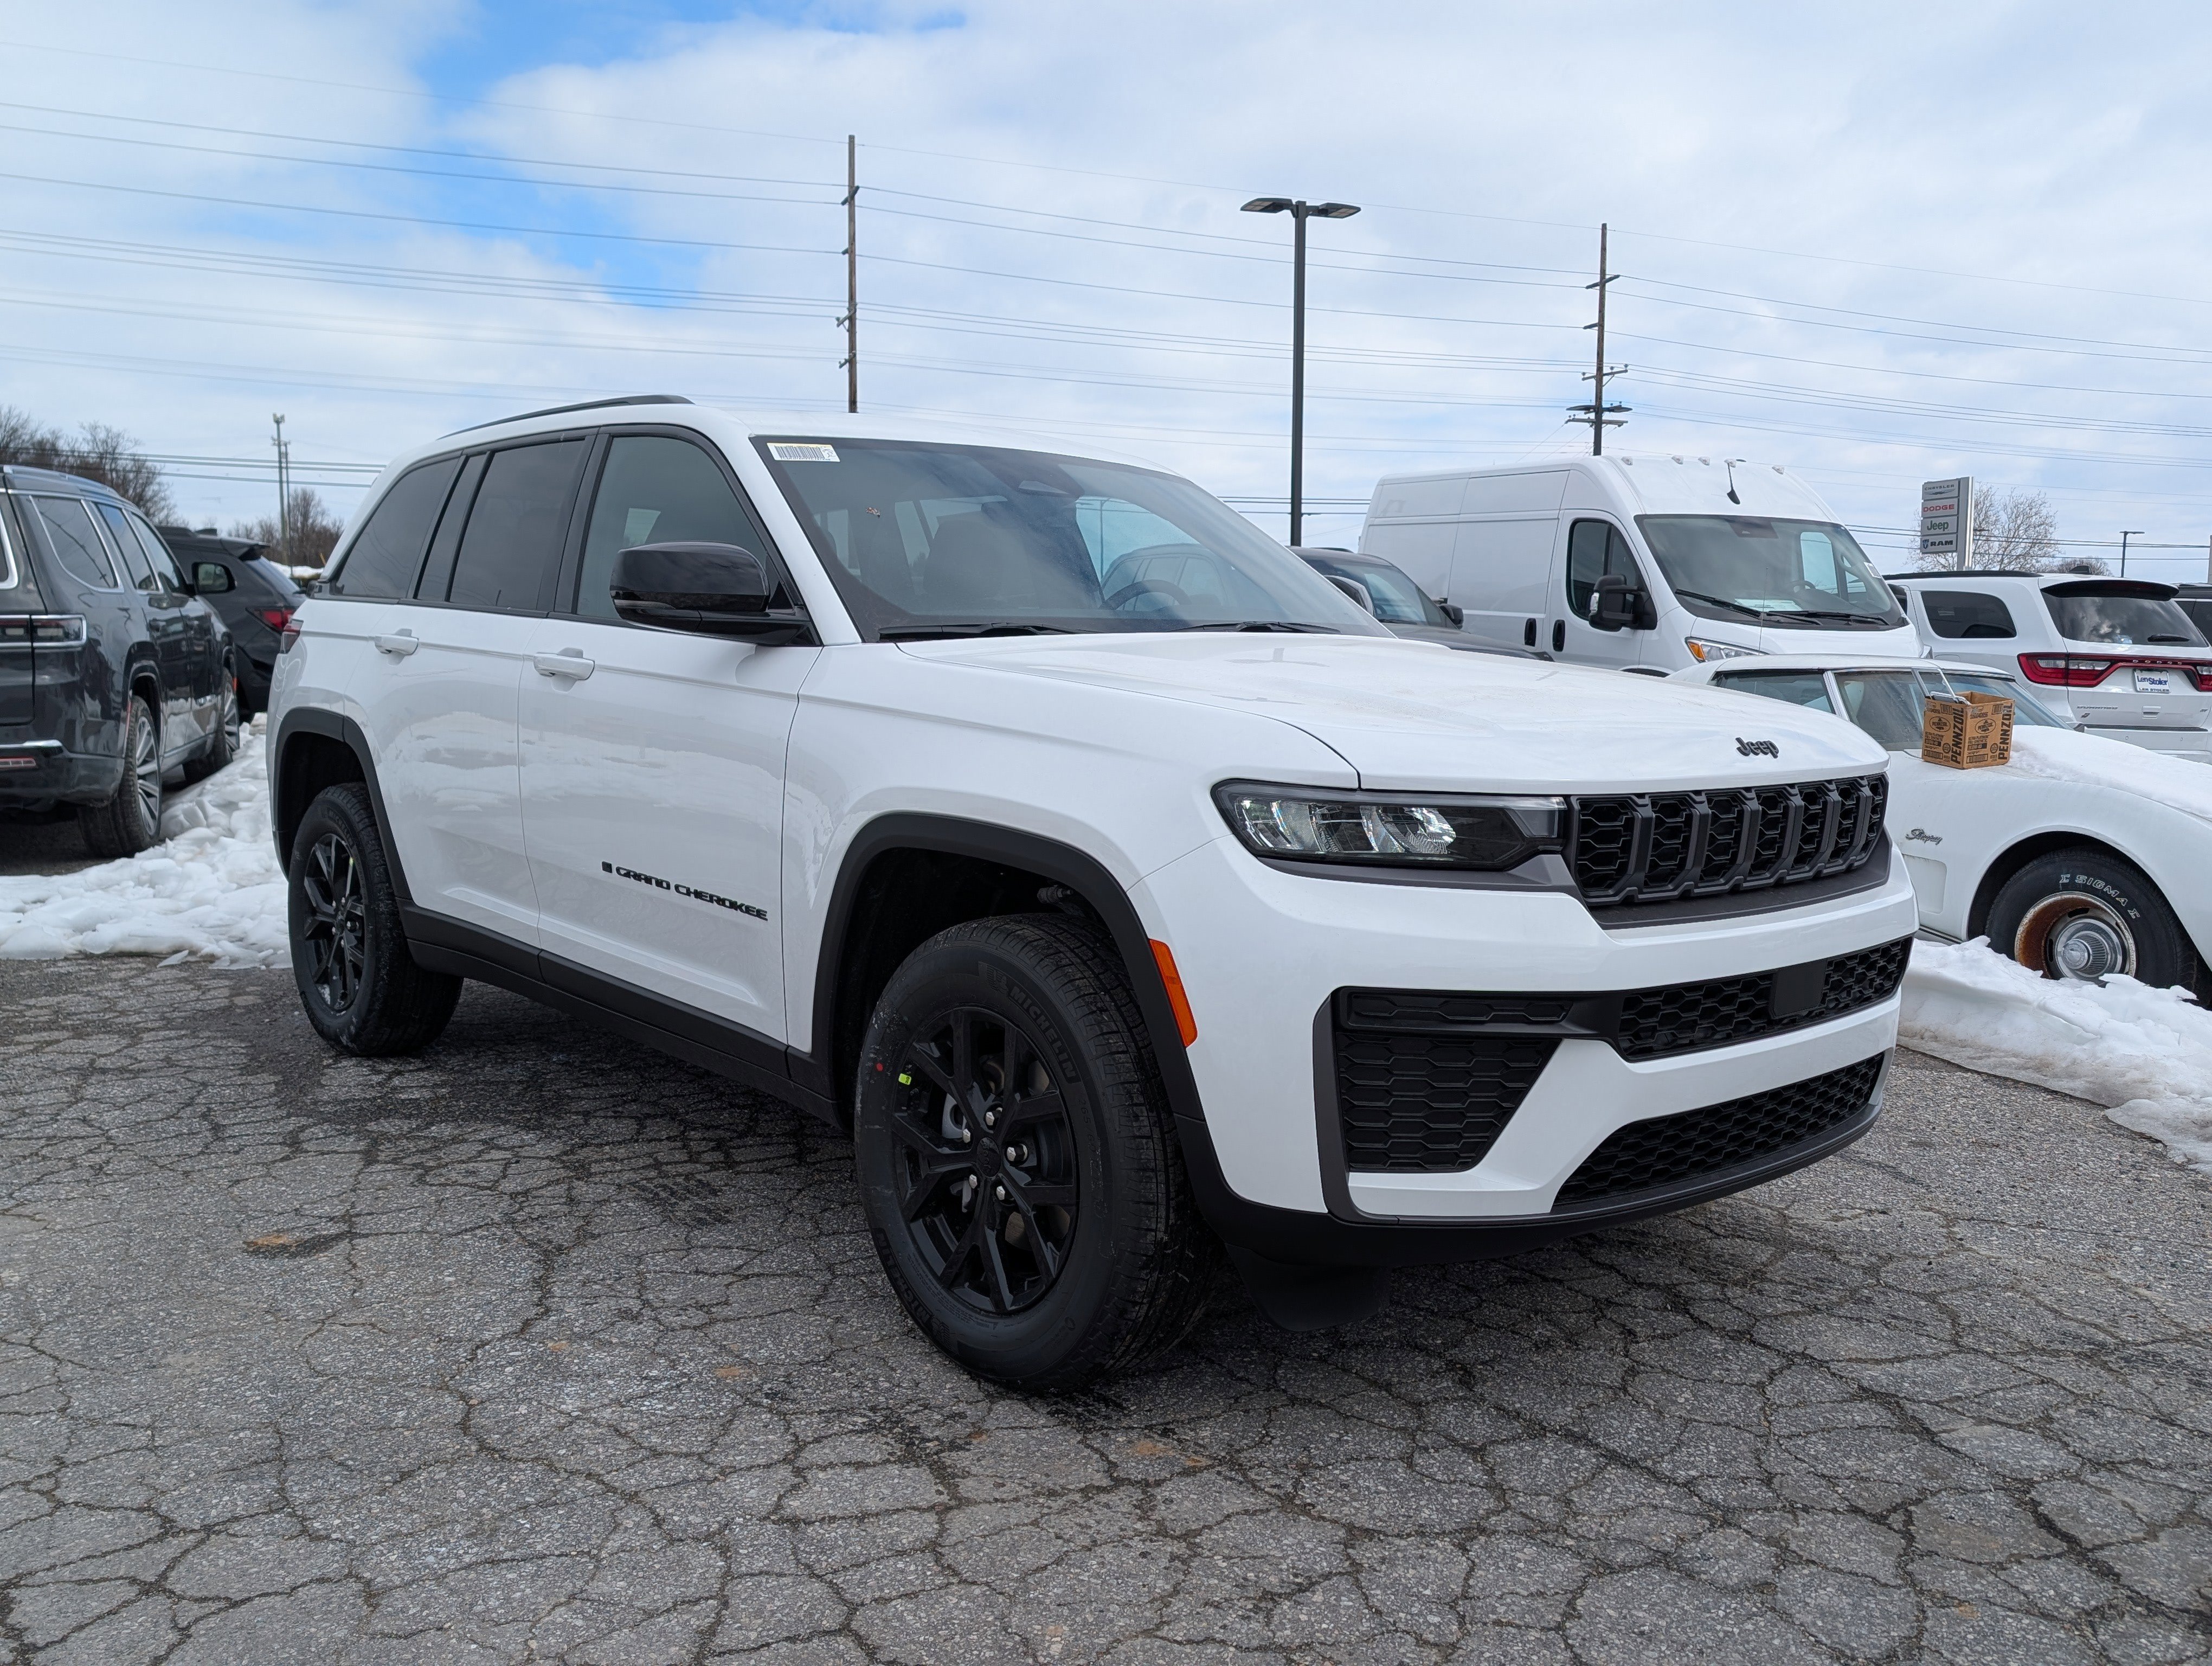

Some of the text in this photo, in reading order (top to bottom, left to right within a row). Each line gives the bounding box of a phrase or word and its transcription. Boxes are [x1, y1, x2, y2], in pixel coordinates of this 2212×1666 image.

[1927, 521, 1949, 531] Jeep
[1735, 737, 1779, 759] Jeep
[1950, 707, 1964, 765] PENNZOIL
[1998, 703, 2012, 760] PENNZOIL
[615, 866, 768, 921] GRAND CHEROKEE
[2075, 874, 2129, 907] SIGMA
[1009, 986, 1076, 1078] MICHELIN
